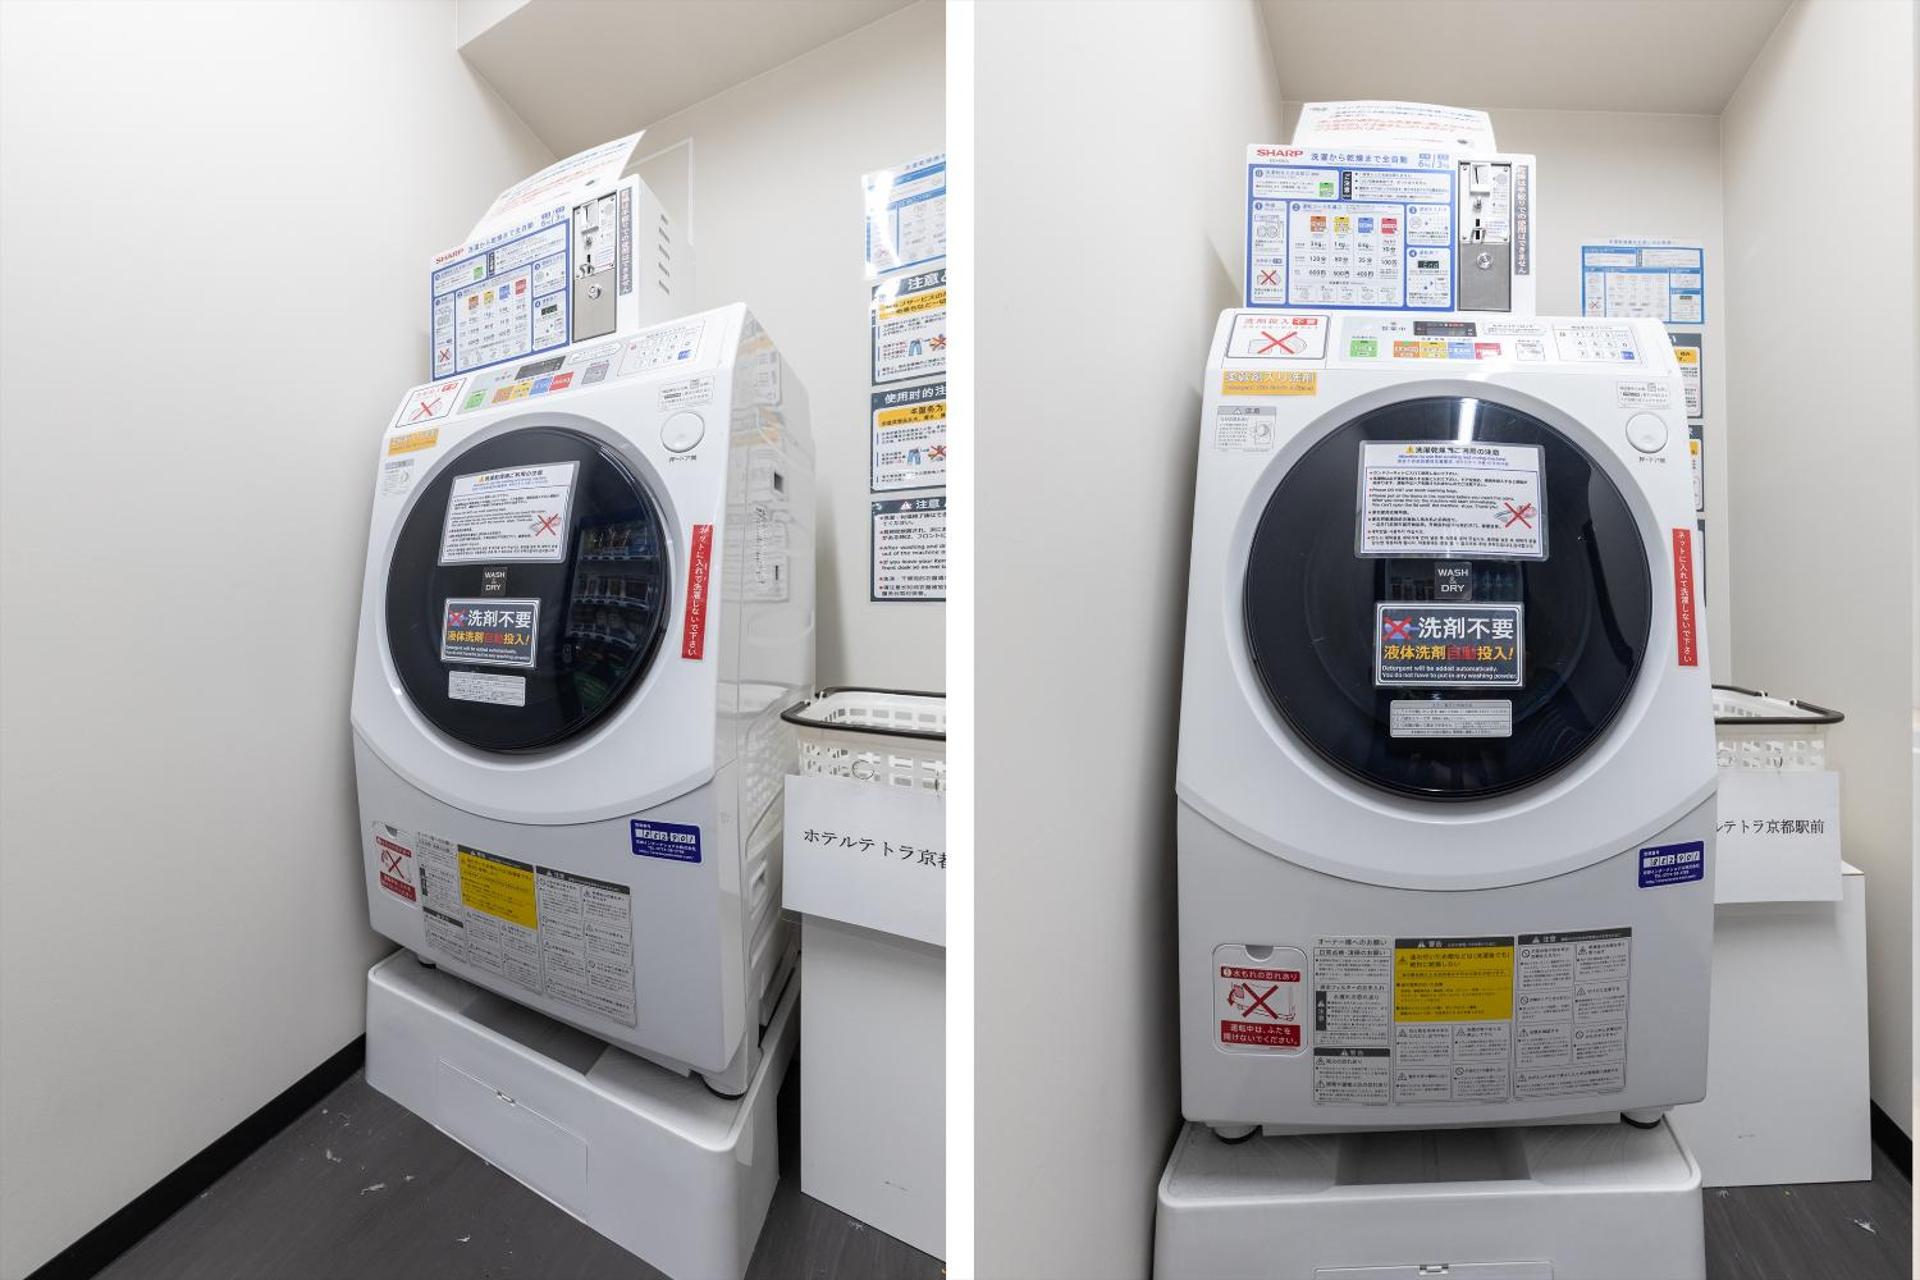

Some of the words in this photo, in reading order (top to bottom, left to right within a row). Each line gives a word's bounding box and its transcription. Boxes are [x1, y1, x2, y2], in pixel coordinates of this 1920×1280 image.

[435, 248, 464, 264] SHARP
[1437, 568, 1469, 577] WASH
[1441, 584, 1465, 592] DRY
[468, 610, 532, 628] 洗剤不要
[1418, 616, 1514, 640] 洗剤不要
[1384, 644, 1514, 660] 液体洗剤自動投入!
[1232, 969, 1298, 980] 水もれの恐れあり
[1230, 1024, 1291, 1035] 運転中は、ふたを
